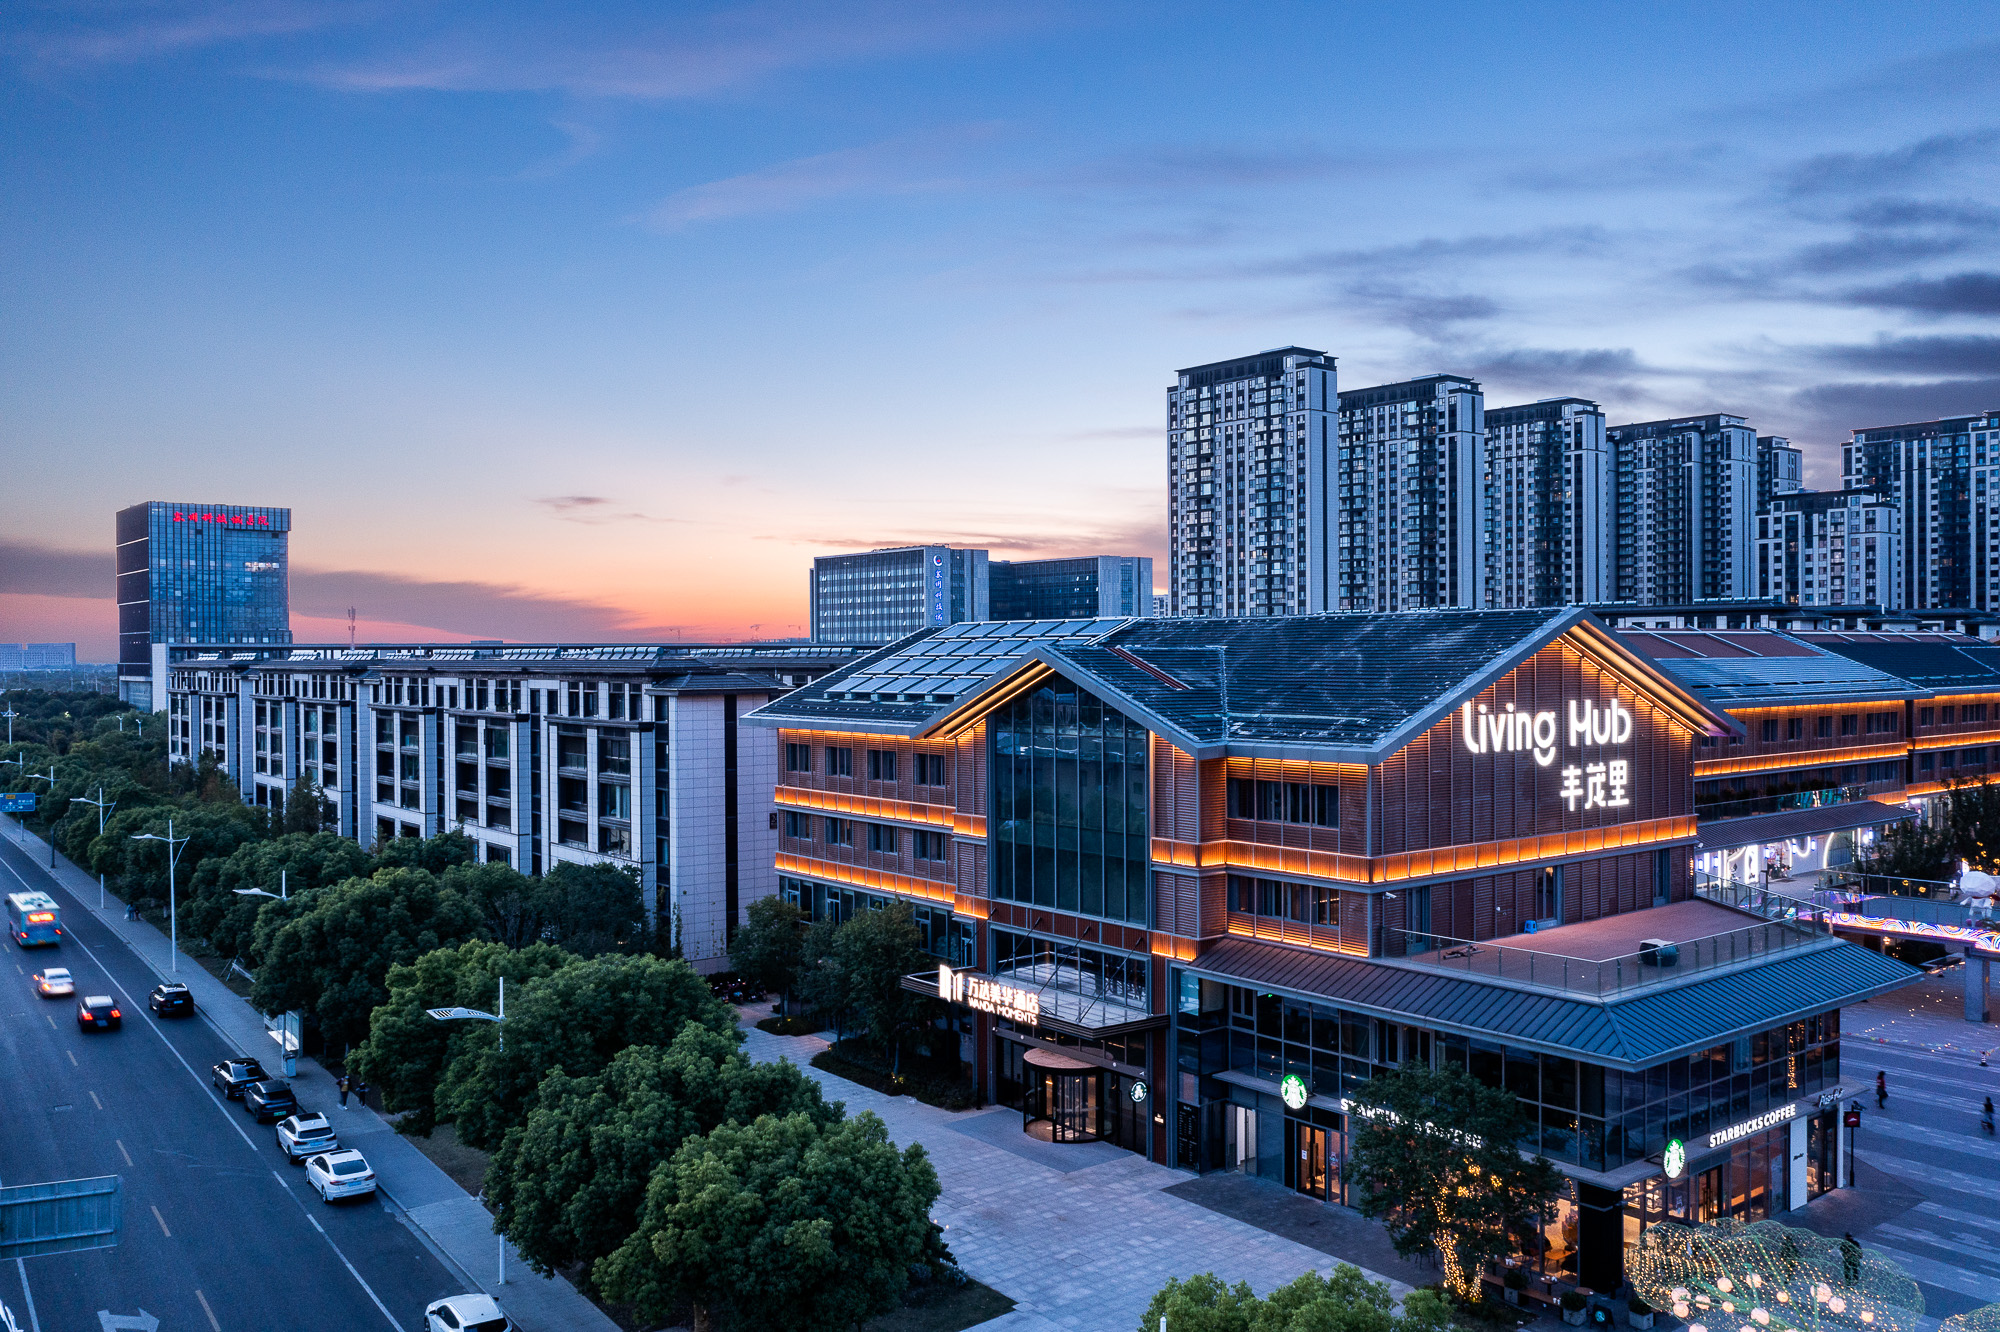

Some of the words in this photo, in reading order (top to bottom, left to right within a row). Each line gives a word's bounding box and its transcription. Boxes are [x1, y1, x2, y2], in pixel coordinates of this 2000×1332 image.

[1462, 700, 1556, 766] Living
[1568, 698, 1632, 747] Hub
[1560, 759, 1630, 812] 丰茂里
[968, 976, 1039, 1015] 万达美华酒店
[968, 996, 996, 1015] WANDA
[997, 1004, 1038, 1026] MOMENTS
[1709, 1116, 1764, 1148] STARBUCKS
[1763, 1104, 1796, 1127] COFFEE
